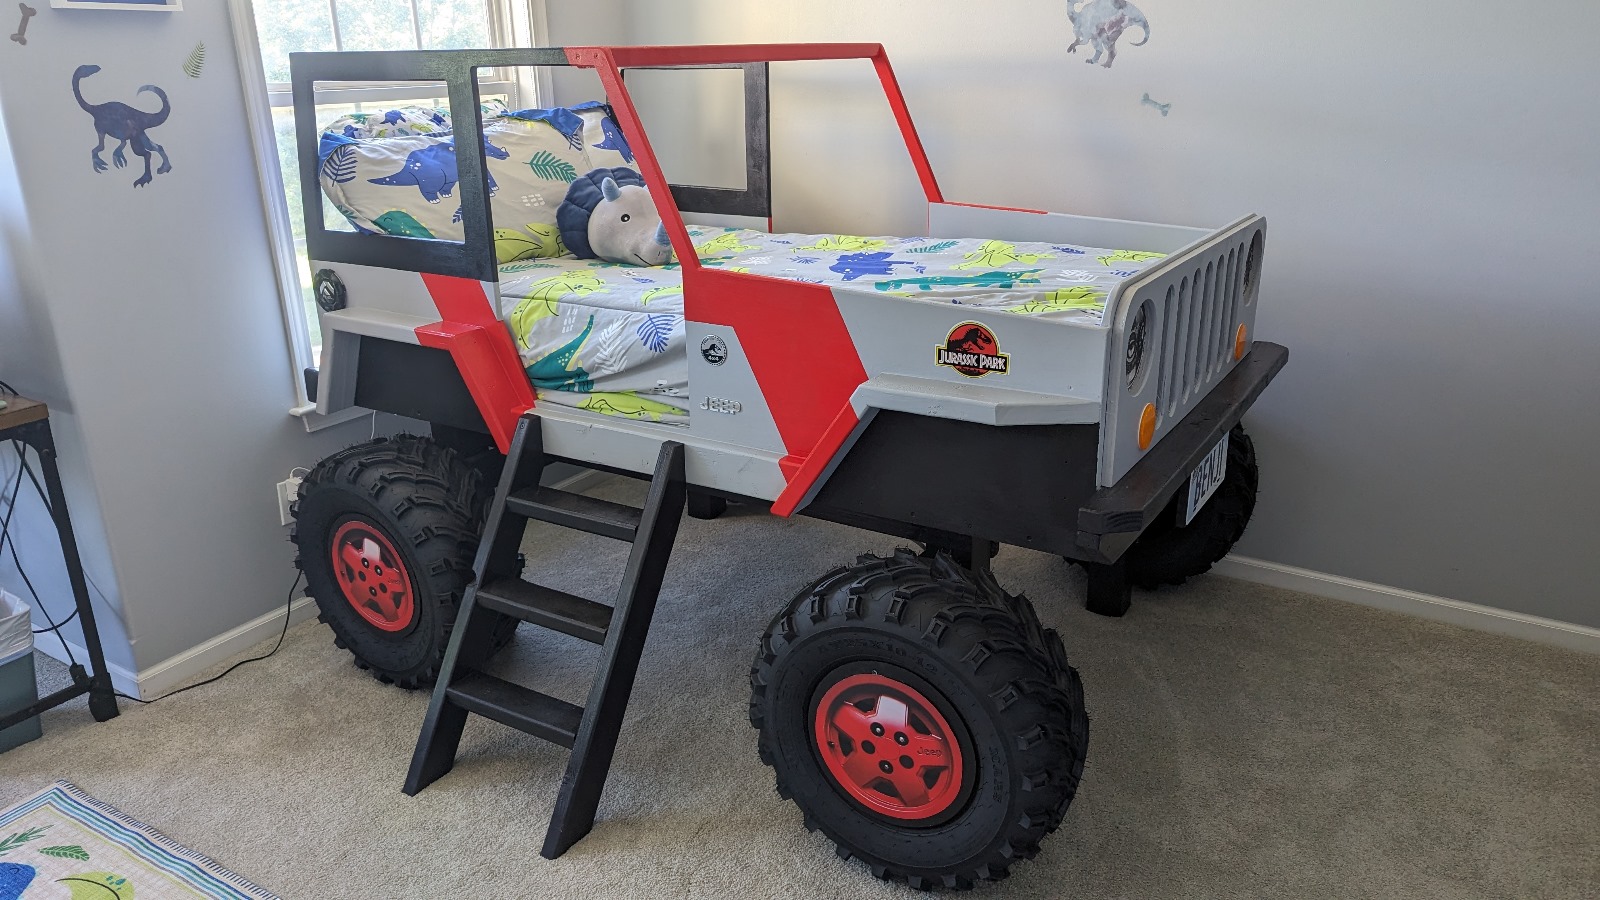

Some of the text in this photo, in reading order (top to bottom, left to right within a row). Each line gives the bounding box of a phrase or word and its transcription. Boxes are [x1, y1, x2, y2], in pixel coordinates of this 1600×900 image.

[938, 349, 1006, 370] JURASSIC PARK
[1194, 438, 1225, 509] BENJI
[917, 746, 942, 758] Jeep
